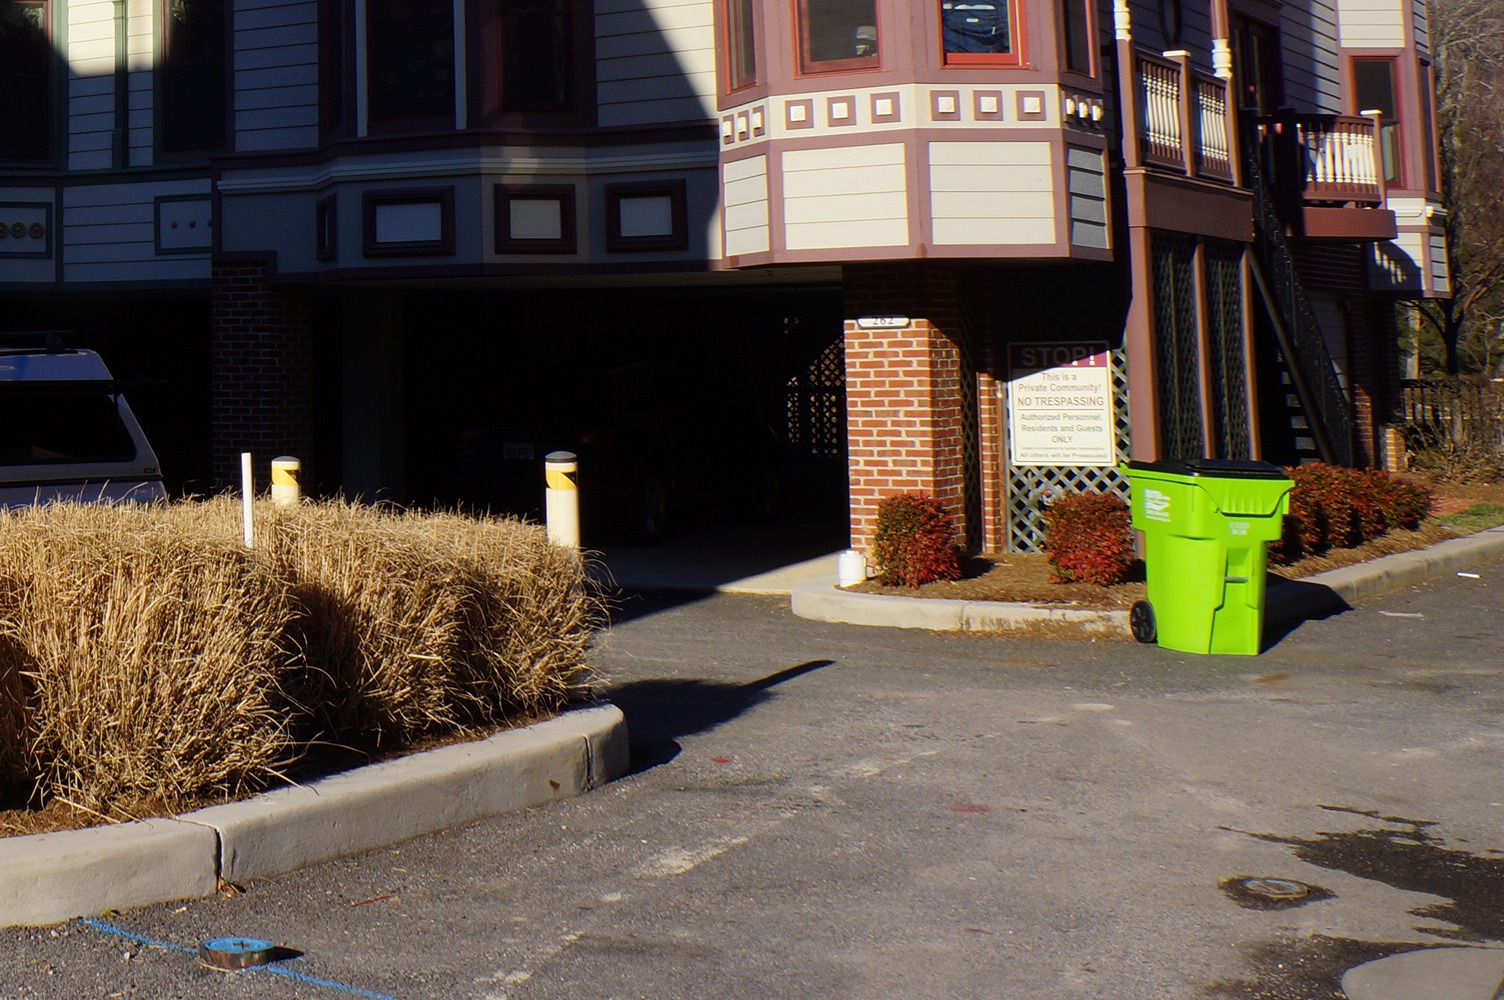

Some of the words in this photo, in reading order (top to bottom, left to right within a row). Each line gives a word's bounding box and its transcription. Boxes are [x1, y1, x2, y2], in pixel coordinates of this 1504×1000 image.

[1022, 346, 1095, 366] STOP!
[1041, 372, 1059, 381] This
[1062, 372, 1069, 381] is
[1018, 383, 1047, 392] Private
[1049, 383, 1101, 393] Community!
[1017, 397, 1032, 406] NO
[1034, 396, 1104, 406] TRESPASSING
[1020, 413, 1061, 421] Authorized
[1021, 424, 1058, 432] Residents
[1059, 424, 1074, 432] and
[1076, 424, 1103, 432] Guests
[1051, 435, 1073, 443] ONLY
